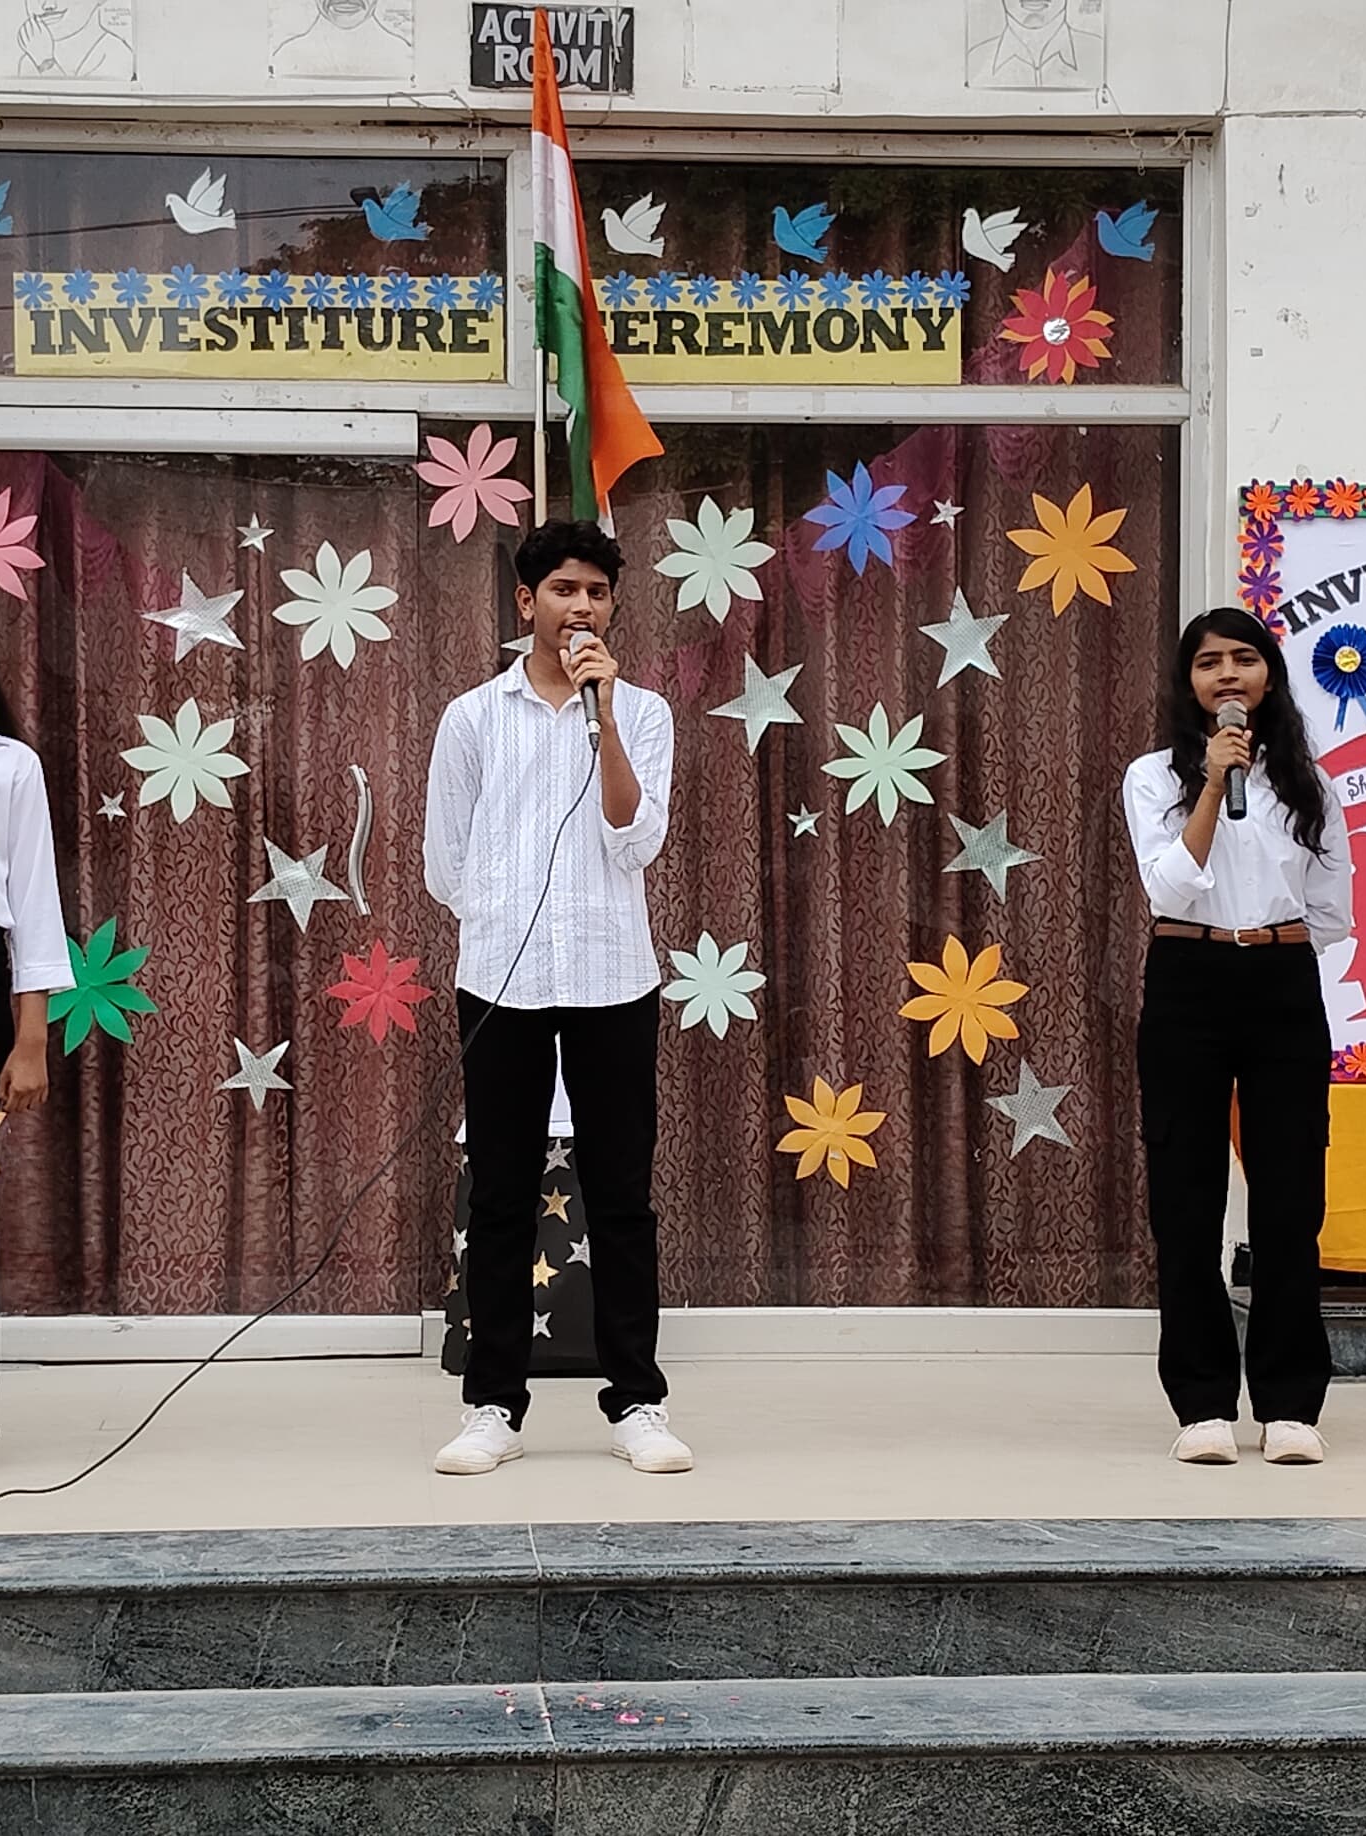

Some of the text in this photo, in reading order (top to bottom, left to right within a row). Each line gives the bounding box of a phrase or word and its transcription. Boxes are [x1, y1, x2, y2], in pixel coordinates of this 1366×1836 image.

[477, 9, 630, 47] ACTIVITY
[30, 306, 955, 356] INVESTITURE EREMONY
